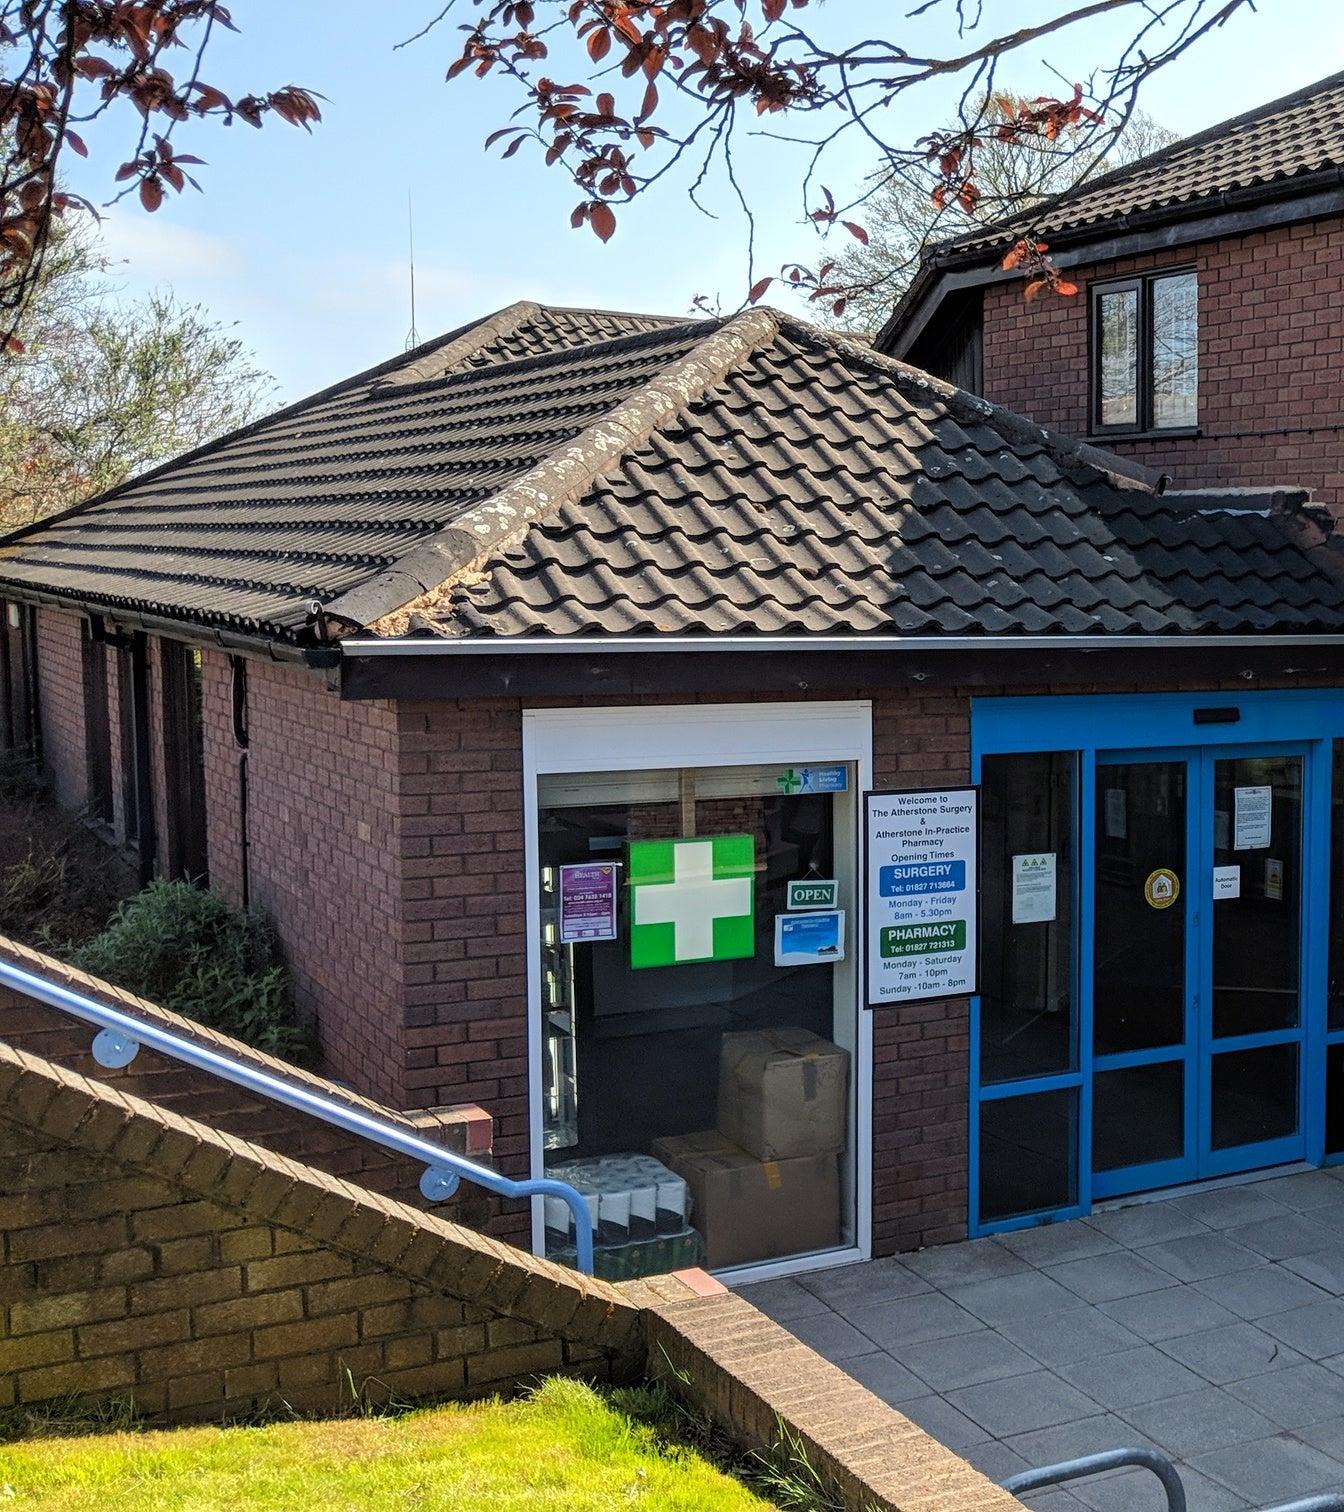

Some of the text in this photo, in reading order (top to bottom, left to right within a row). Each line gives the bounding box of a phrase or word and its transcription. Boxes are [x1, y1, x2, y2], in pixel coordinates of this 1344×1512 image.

[898, 796, 937, 805] Welcome
[872, 805, 972, 817] The Atherstone Surgery
[920, 817, 926, 825] &
[876, 826, 970, 839] Atherstone In-Practice
[902, 839, 944, 847] Pharmacy
[891, 851, 955, 863] Opening Times
[894, 864, 951, 879] SURGERY
[891, 885, 904, 893] Tel:
[905, 883, 927, 892] 01827
[794, 889, 831, 901] OPEN
[888, 899, 923, 908] Monday
[930, 896, 957, 905] Friday
[894, 911, 913, 920] 8am
[921, 908, 952, 918] 5.30pm
[888, 924, 956, 941] PHARMACY
[905, 944, 927, 952] 01827
[883, 961, 917, 970] Monday
[925, 955, 962, 966] Saturday
[899, 972, 917, 980] 7am
[925, 968, 948, 977] 10pm
[880, 985, 912, 995] Sunday
[948, 979, 966, 988] 8pm
